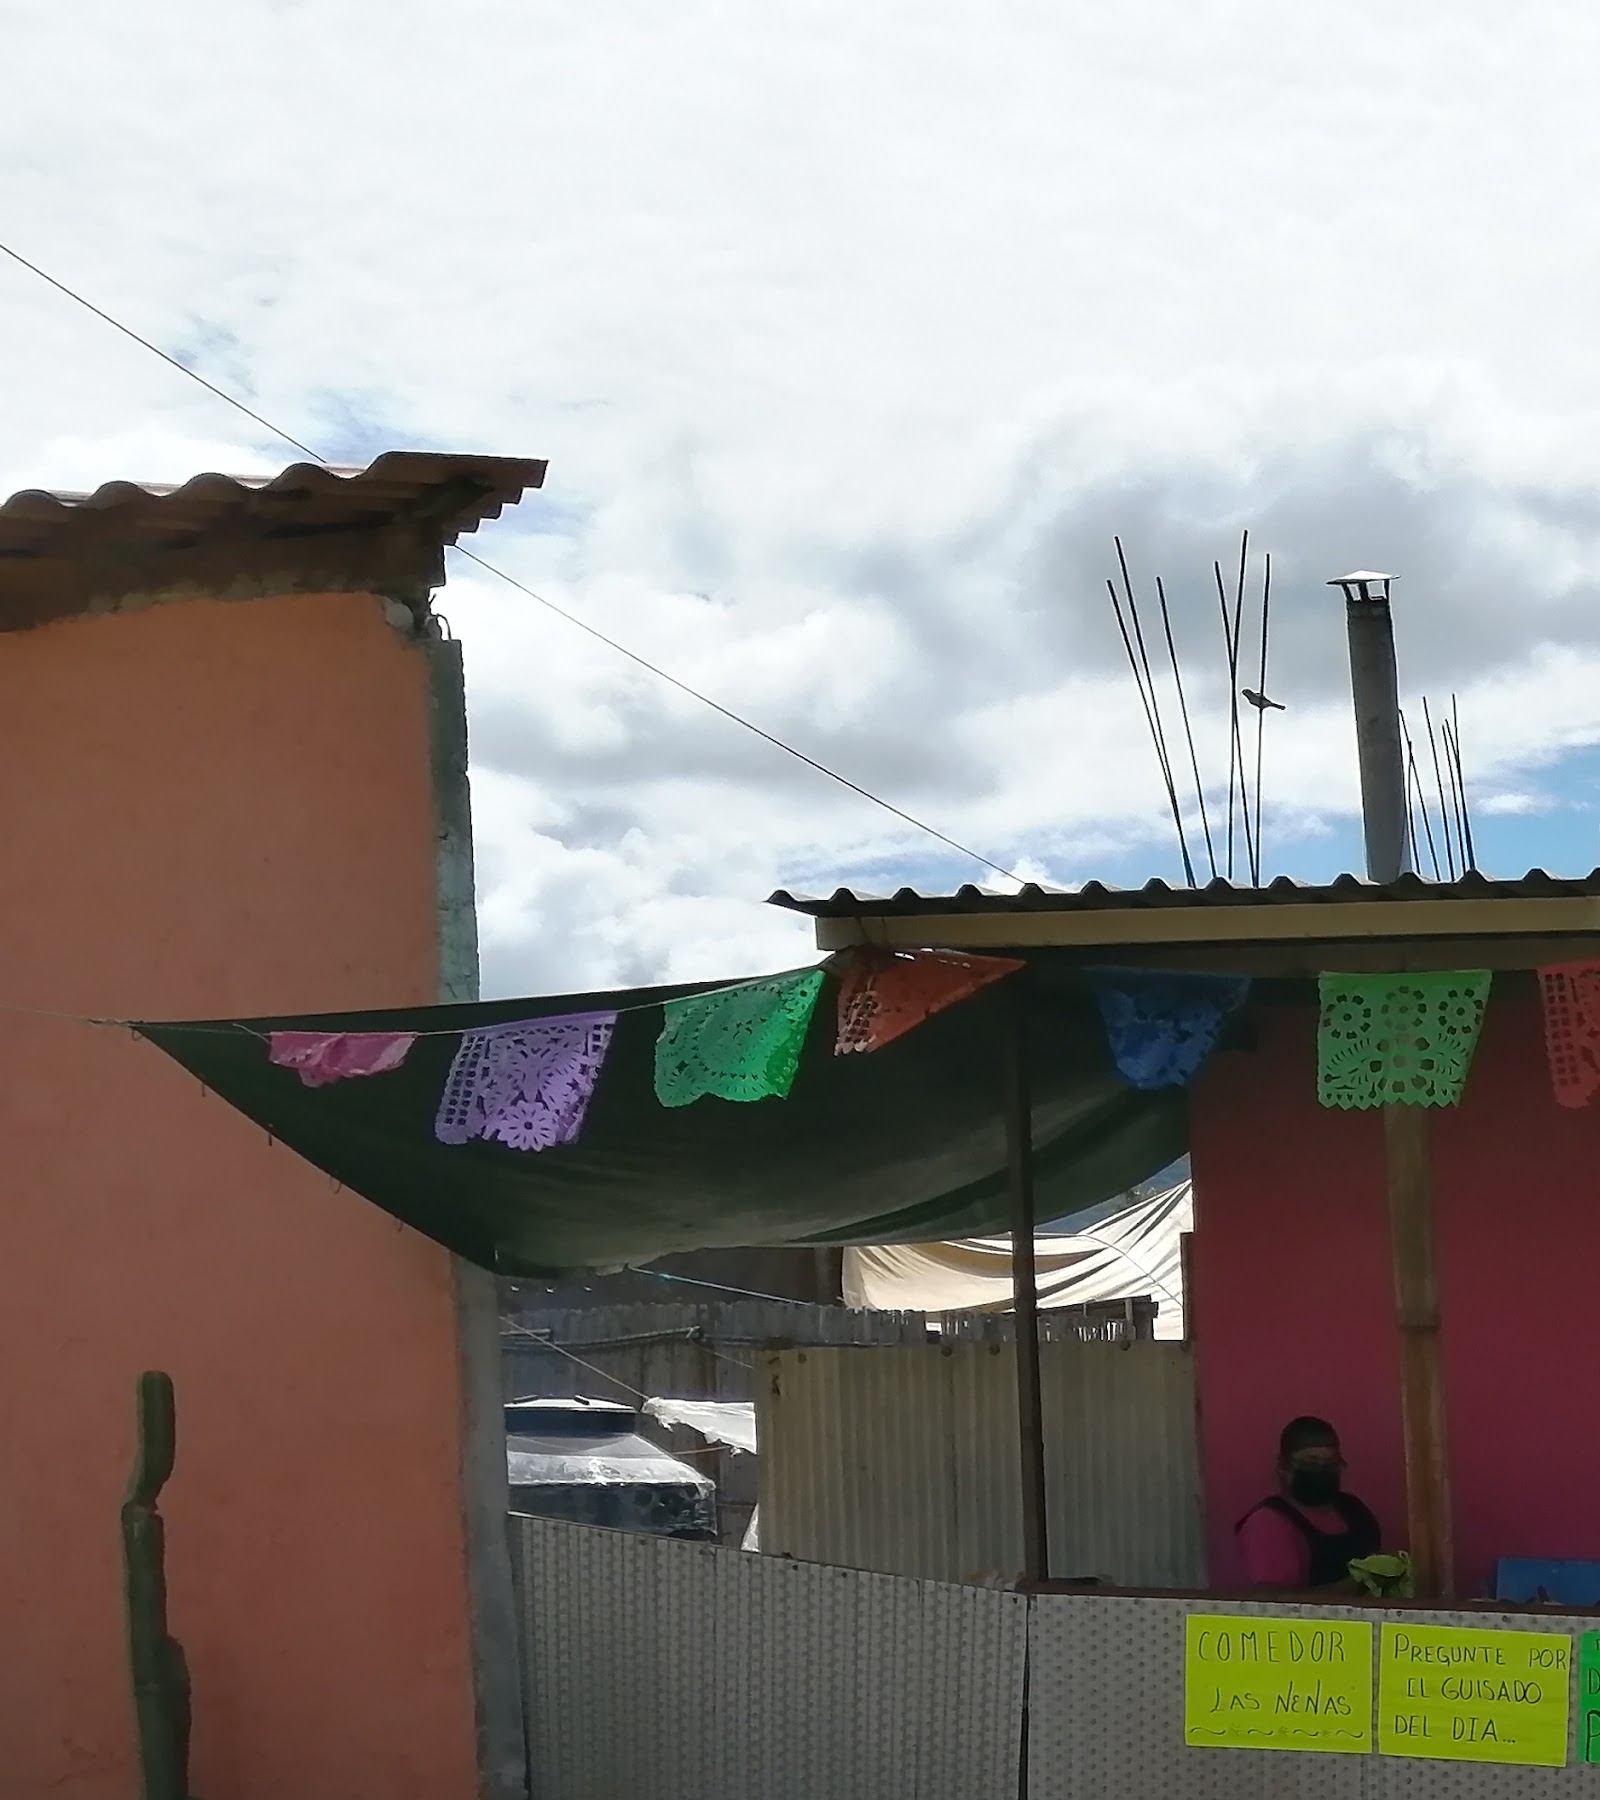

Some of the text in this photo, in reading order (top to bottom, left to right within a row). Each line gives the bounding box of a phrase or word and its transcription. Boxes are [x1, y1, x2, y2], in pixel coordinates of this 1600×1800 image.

[1198, 1630, 1345, 1663] COMEDOR
[1394, 1633, 1567, 1670] PREGUNTE POR
[1209, 1679, 1352, 1716] LAS NENAS
[1407, 1676, 1543, 1705] EL GUISADO
[1394, 1714, 1432, 1738] DEL
